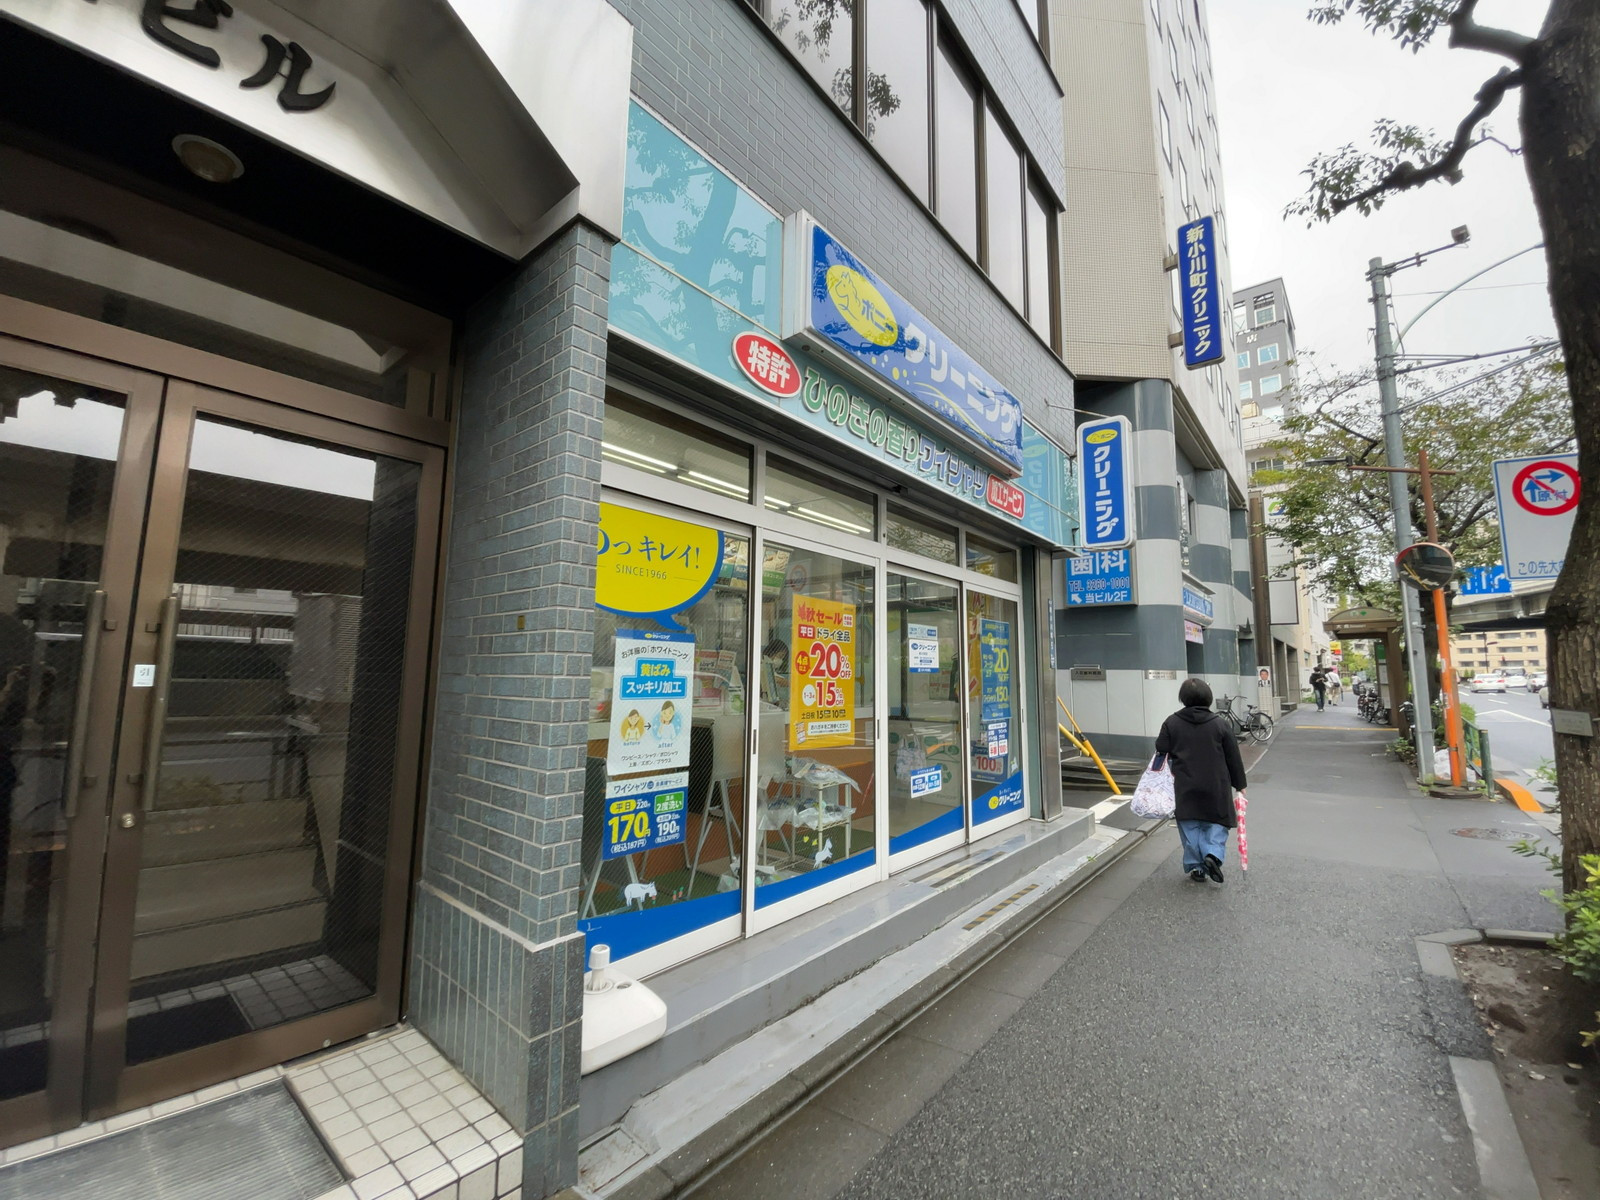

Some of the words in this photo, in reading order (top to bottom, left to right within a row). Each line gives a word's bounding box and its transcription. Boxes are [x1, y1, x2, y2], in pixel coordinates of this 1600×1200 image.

[1186, 224, 1211, 357] 新小川町クリニック
[861, 298, 894, 333] ポニー
[748, 340, 791, 389] 特許
[902, 321, 1020, 434] クリーニング
[1093, 445, 1119, 538] クリーニング
[1069, 580, 1085, 592] TEL
[1085, 590, 1128, 604] 当ビル2F
[800, 625, 815, 637] 平日
[816, 627, 850, 642] ドライ全品
[641, 663, 671, 677] 黄ばみ
[626, 681, 682, 694] スッキリ加工
[614, 782, 647, 794] ワイシャツ
[616, 801, 631, 811] 平日
[998, 789, 1022, 806] クリーニング
